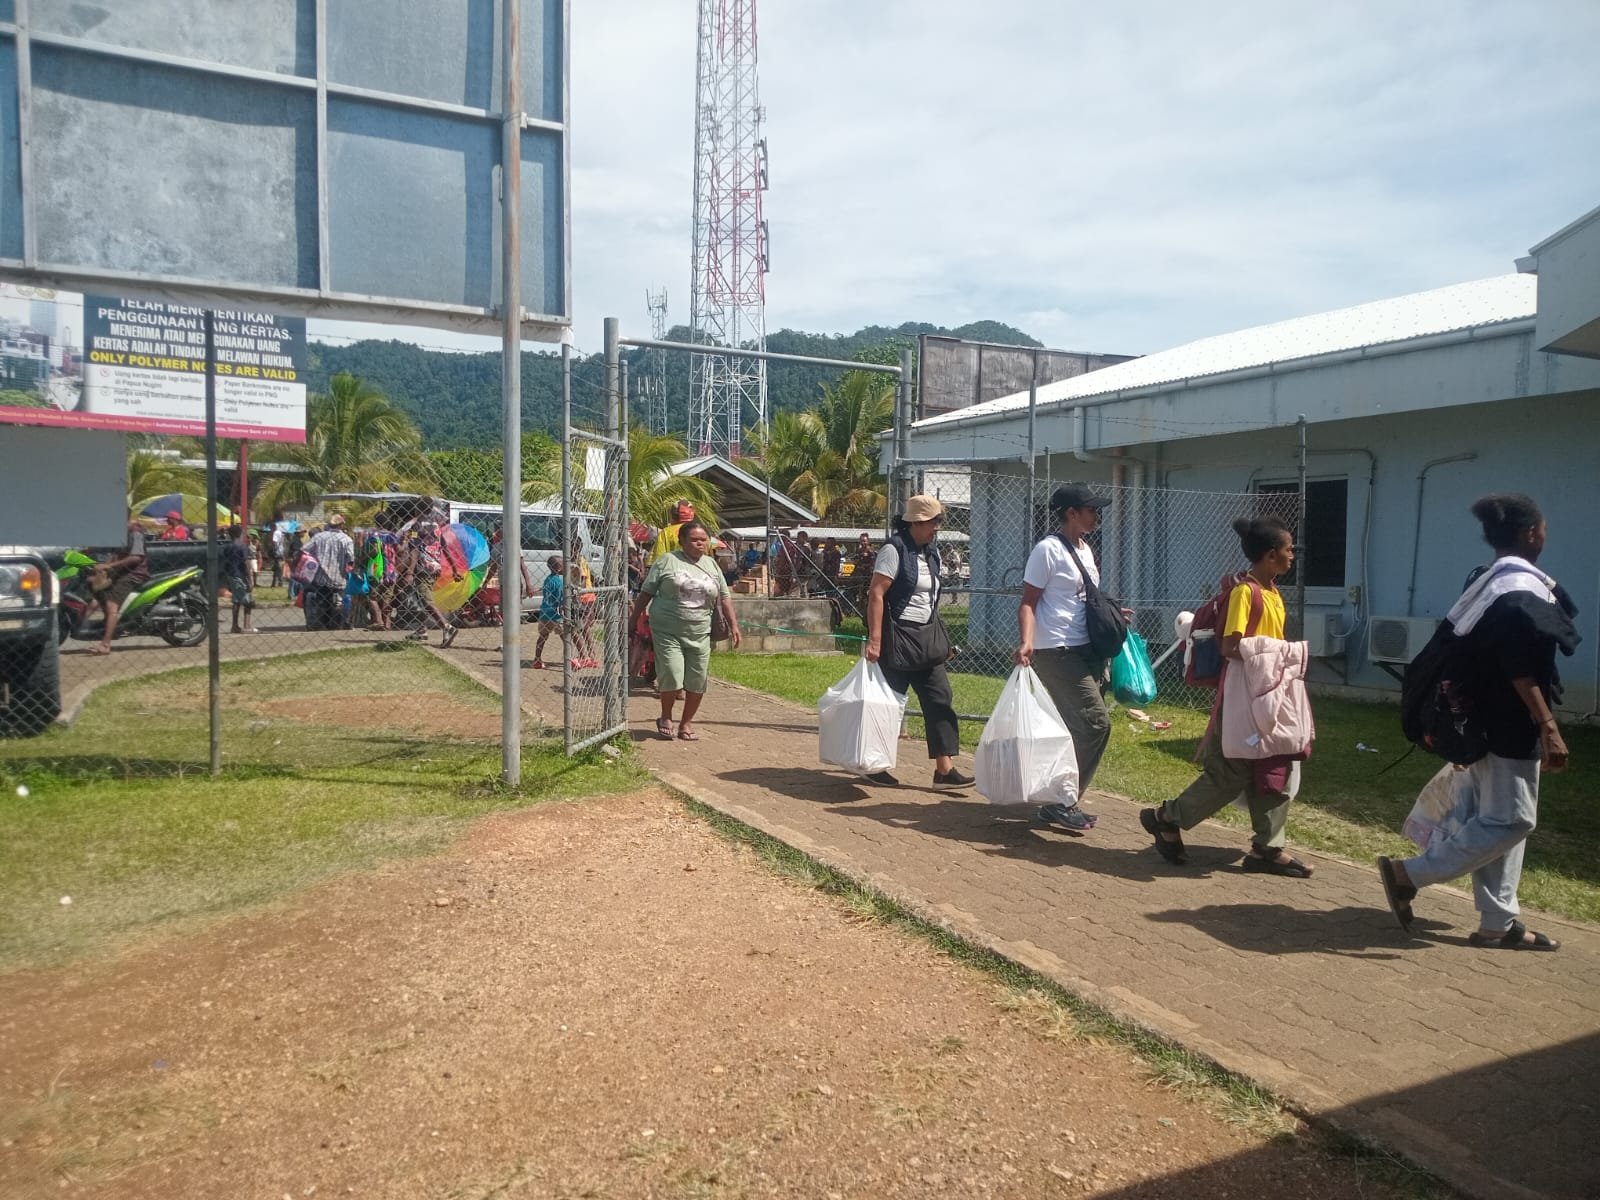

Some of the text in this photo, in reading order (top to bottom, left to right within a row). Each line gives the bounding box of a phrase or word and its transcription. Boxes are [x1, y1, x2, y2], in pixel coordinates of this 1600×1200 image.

[121, 298, 163, 312] TELAH
[98, 308, 196, 329] PENGGUNAAN
[242, 324, 292, 340] KERTAS.
[110, 323, 160, 340] MENERIMA
[164, 329, 184, 342] ATAU
[257, 340, 280, 352] UANG
[90, 351, 296, 380] ONLY POLYMER NOES ARE VALID
[94, 336, 128, 352] KERTAS
[132, 340, 166, 355] ADALAH
[217, 350, 260, 364] MELAWAN
[262, 354, 294, 368] HUKUM.
